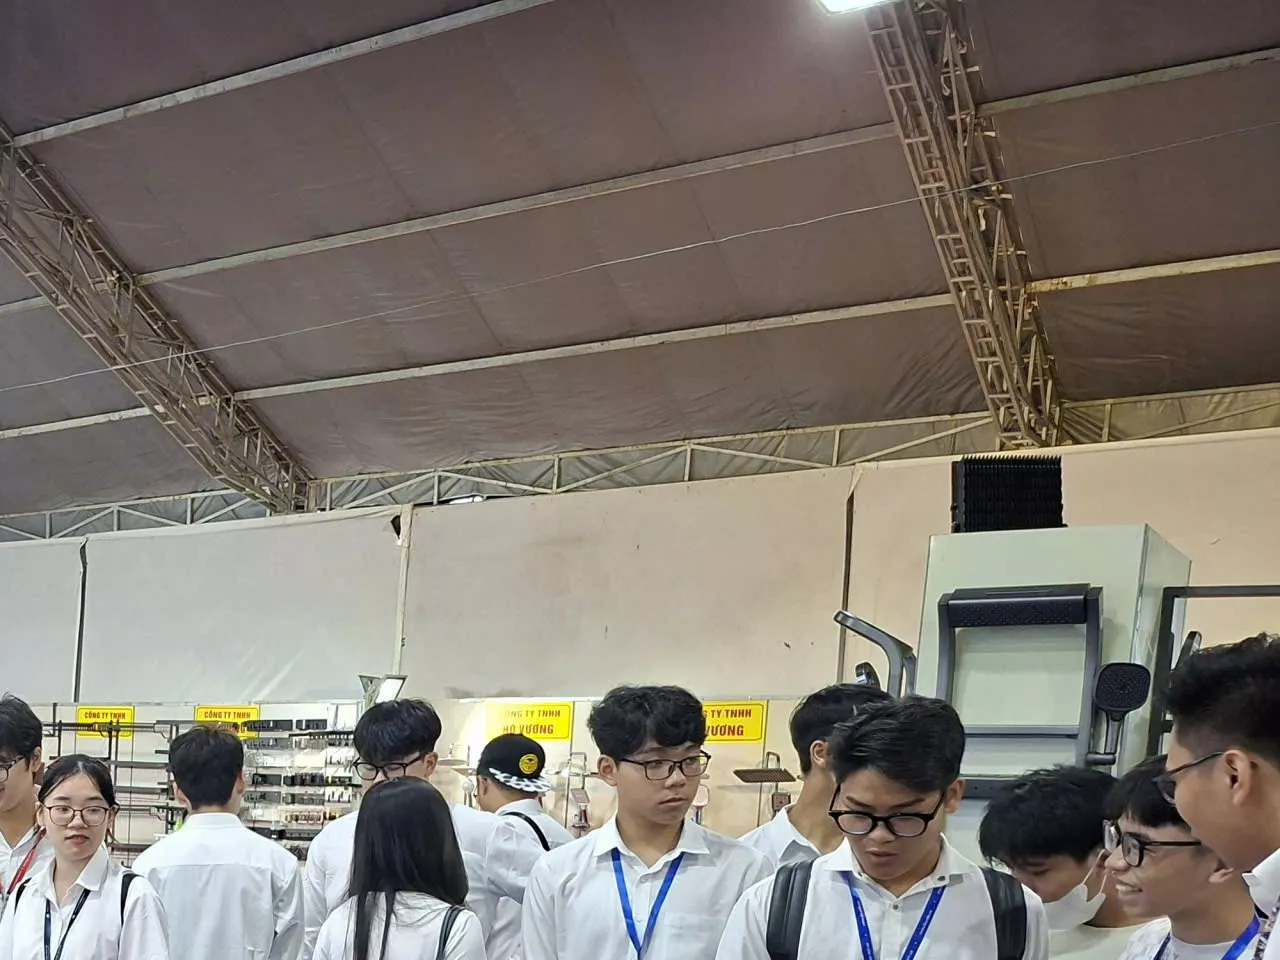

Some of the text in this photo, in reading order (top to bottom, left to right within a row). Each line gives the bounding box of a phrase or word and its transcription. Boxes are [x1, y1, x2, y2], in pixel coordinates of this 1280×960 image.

[84, 710, 101, 719] CÔNG
[110, 711, 126, 720] TNHH
[204, 709, 251, 719] CÔNG TY TNHH
[525, 709, 535, 718] TY
[538, 709, 561, 718] TNHH
[710, 708, 722, 719] TY
[725, 708, 752, 719] TNHH
[519, 722, 554, 735] VƯƠNG
